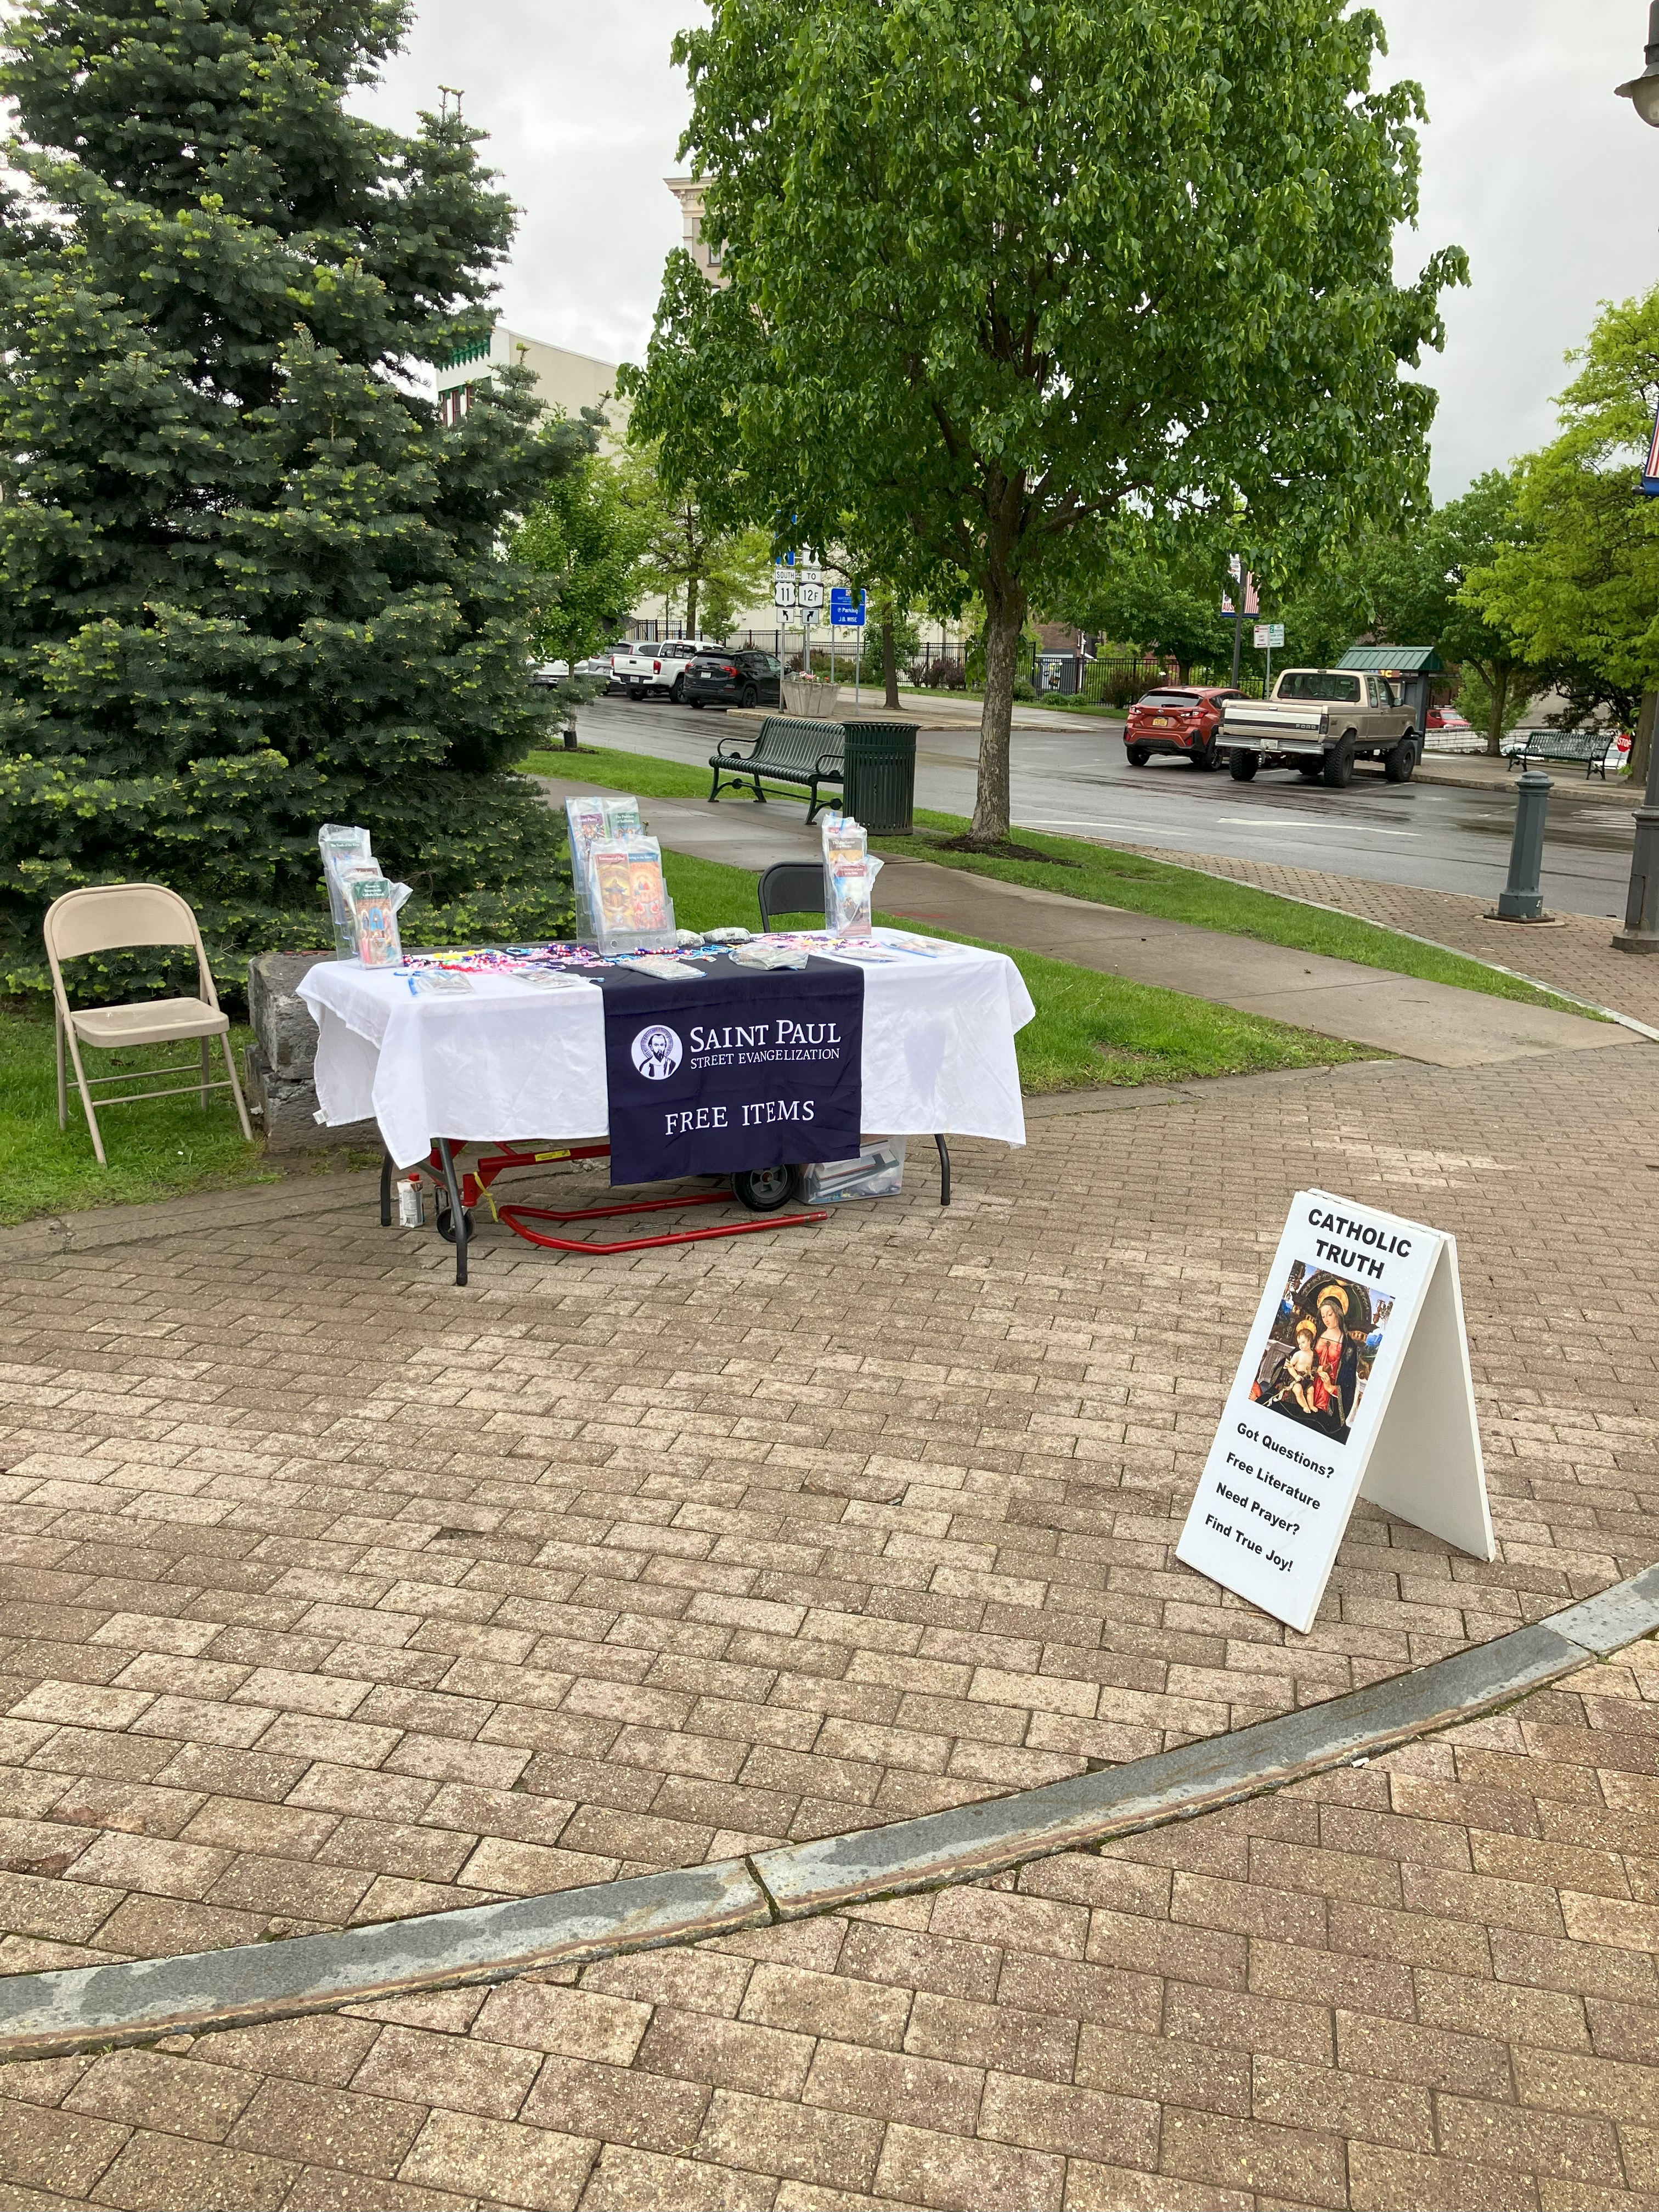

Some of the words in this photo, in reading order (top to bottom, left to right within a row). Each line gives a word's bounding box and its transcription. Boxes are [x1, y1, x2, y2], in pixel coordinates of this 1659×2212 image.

[781, 588, 789, 601] 11
[804, 589, 819, 601] 12F
[1617, 737, 1632, 748] STOP
[690, 1053, 735, 1069] STREET
[738, 1048, 840, 1064] EVANGELIZATION
[664, 1106, 729, 1136] FREE
[741, 1100, 815, 1126] ITEMS
[1308, 1209, 1412, 1258] CATHOLIC
[1316, 1239, 1386, 1280] TRUTH
[1237, 1422, 1260, 1442] Got
[1262, 1435, 1335, 1479] Questions?
[1226, 1452, 1254, 1475] Free
[1256, 1467, 1321, 1510] Literature
[1215, 1481, 1250, 1508] Need
[1250, 1500, 1301, 1536] Prayer?
[1205, 1513, 1233, 1538] Find
[1235, 1530, 1263, 1555] True
[1265, 1549, 1294, 1572] Joy!
